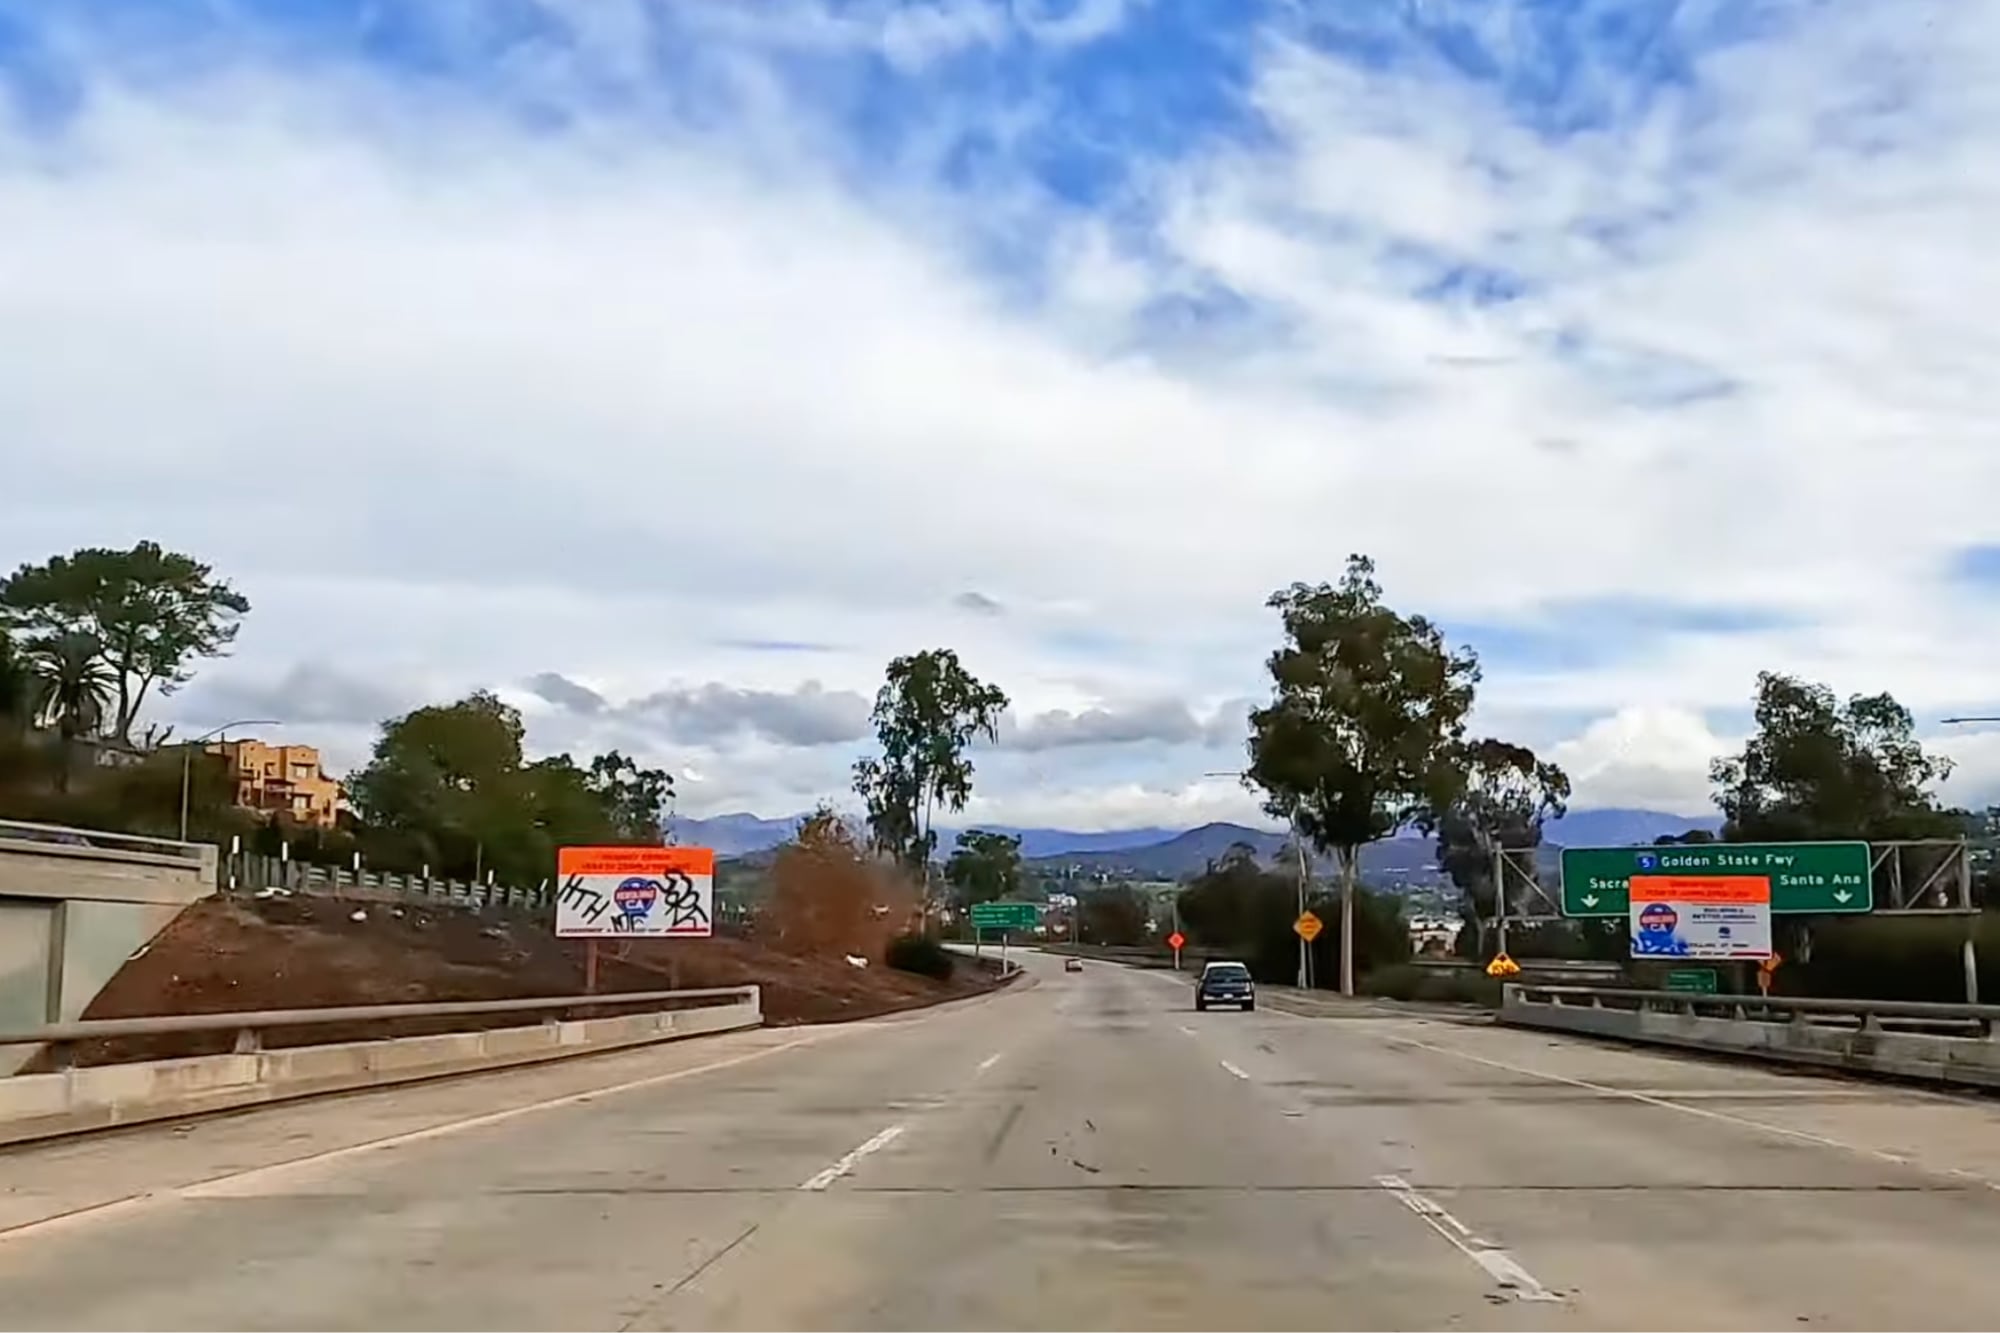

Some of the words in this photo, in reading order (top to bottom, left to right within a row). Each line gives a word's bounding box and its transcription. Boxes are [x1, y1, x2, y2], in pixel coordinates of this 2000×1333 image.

[1642, 857, 1651, 868] 5
[1661, 856, 1710, 868] Golden
[1717, 854, 1759, 866] State
[1765, 853, 1794, 867] Fwy
[1780, 874, 1824, 886] Santa
[1832, 873, 1861, 885] Ana
